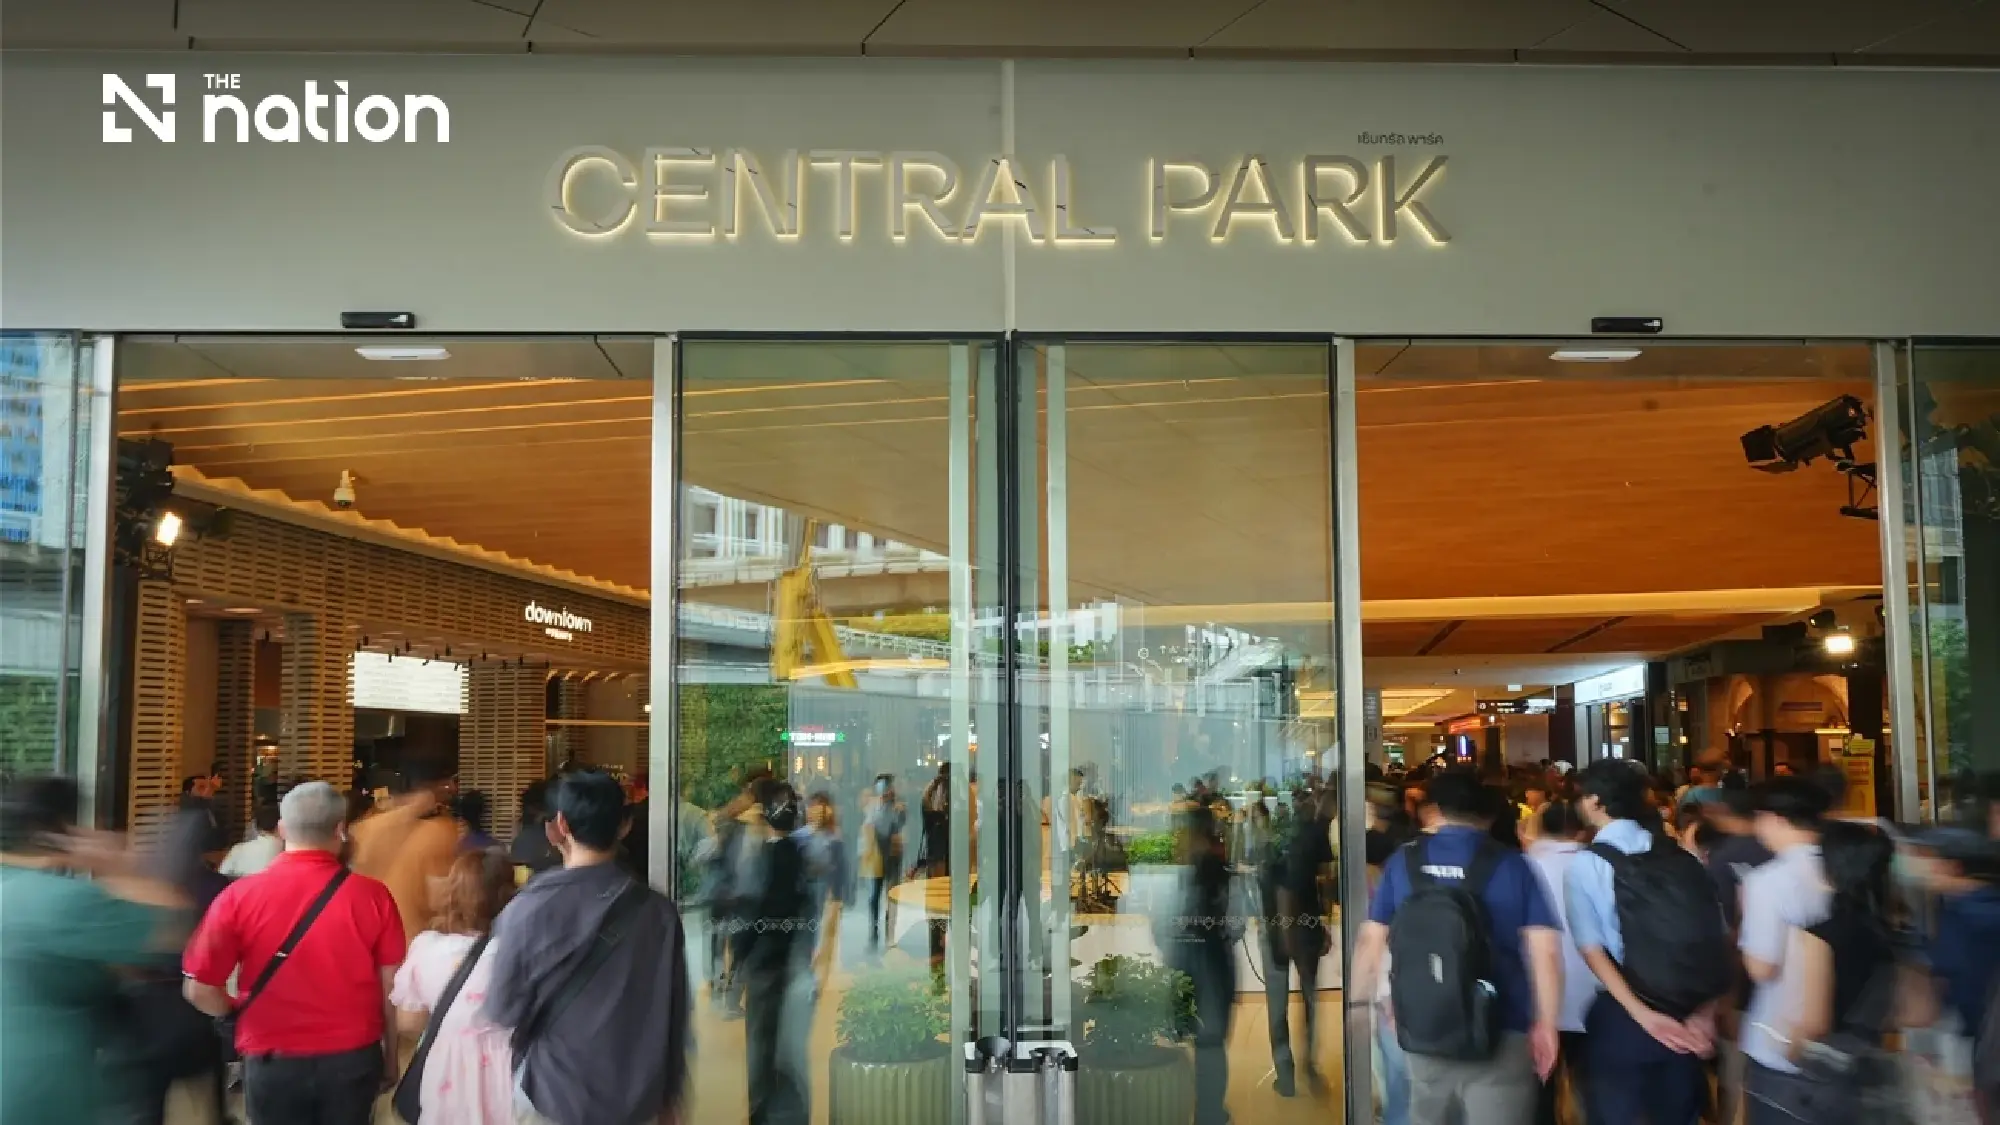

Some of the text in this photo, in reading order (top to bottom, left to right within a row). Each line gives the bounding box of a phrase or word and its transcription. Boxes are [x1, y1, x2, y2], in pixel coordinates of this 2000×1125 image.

[548, 144, 1452, 244] CENTRAL PARK
[525, 600, 592, 633] downtown
